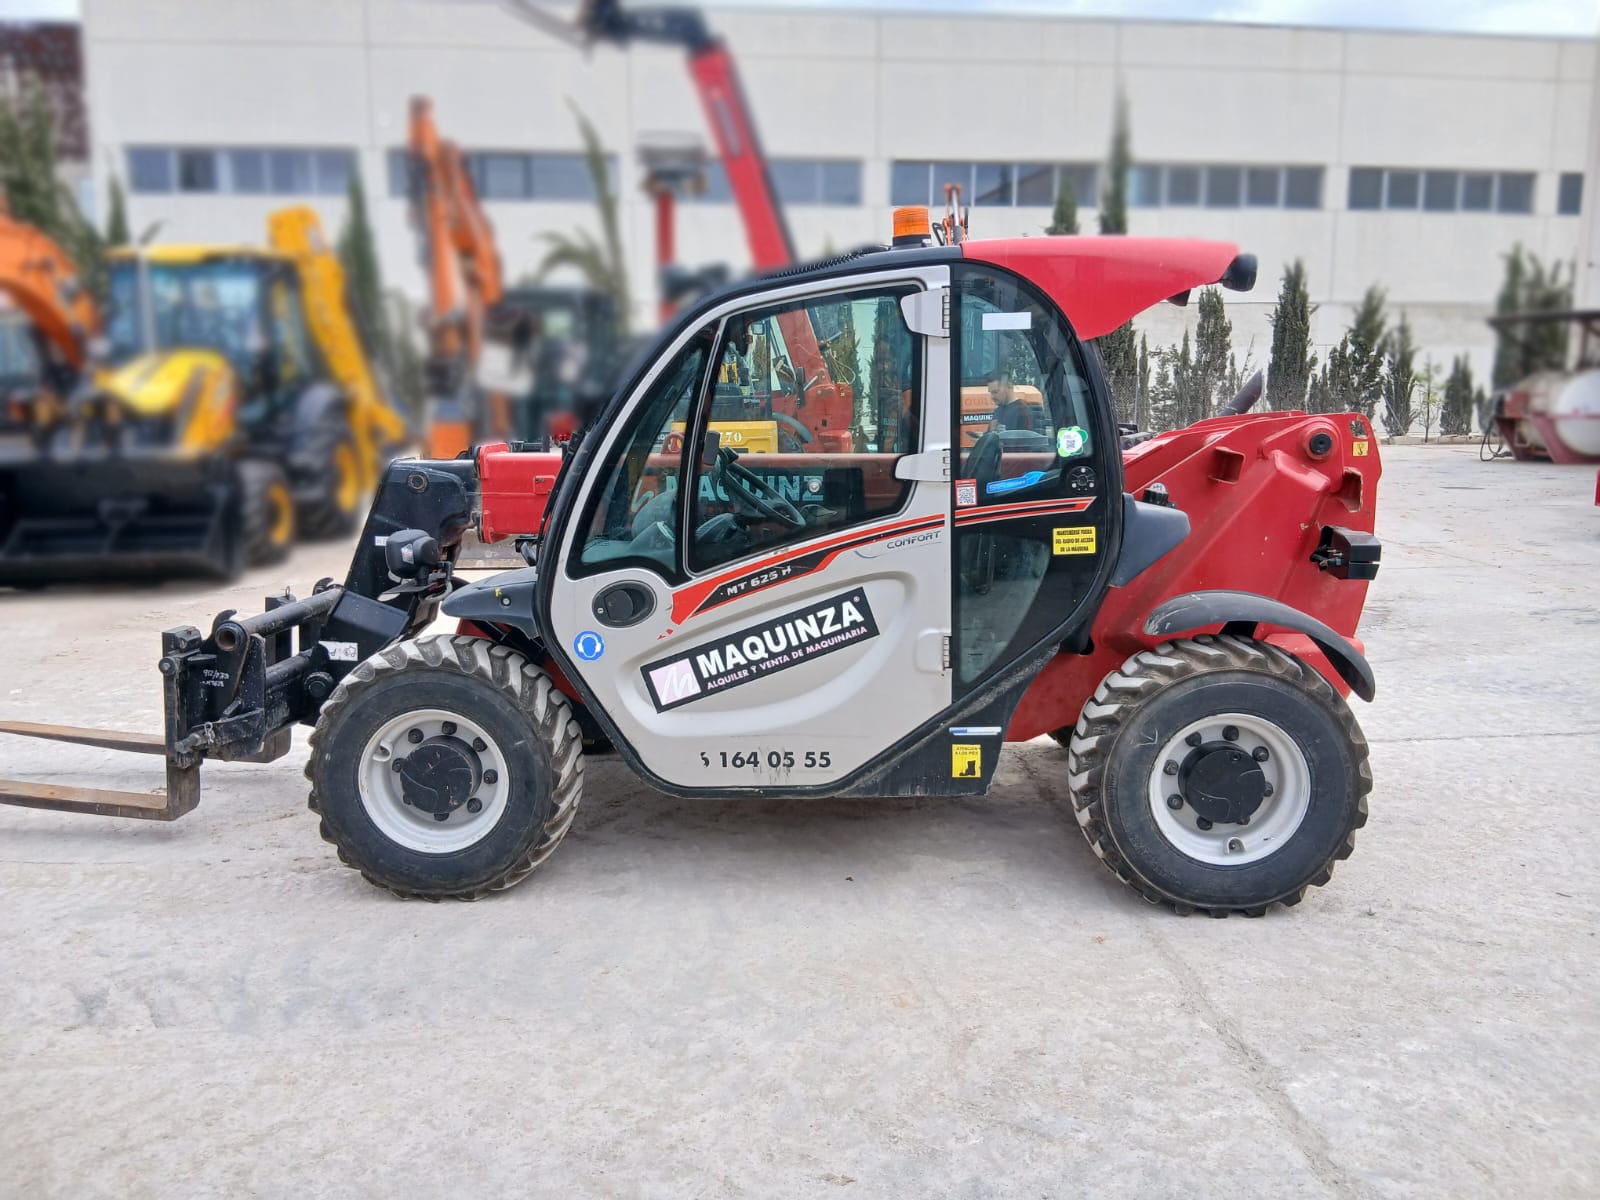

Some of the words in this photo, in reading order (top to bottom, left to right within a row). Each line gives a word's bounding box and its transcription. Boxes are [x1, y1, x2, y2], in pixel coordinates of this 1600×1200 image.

[886, 530, 942, 549] COMFORT
[727, 581, 747, 596] MT
[750, 570, 778, 587] 625
[781, 565, 792, 576] H
[707, 669, 750, 690] ALQUILER
[750, 665, 758, 674] Y
[759, 654, 790, 671] VENTA
[791, 649, 804, 660] DE
[806, 626, 868, 654] MAQUINARIA
[719, 751, 760, 769] 164
[767, 750, 795, 769] 05
[804, 751, 831, 769] 55
